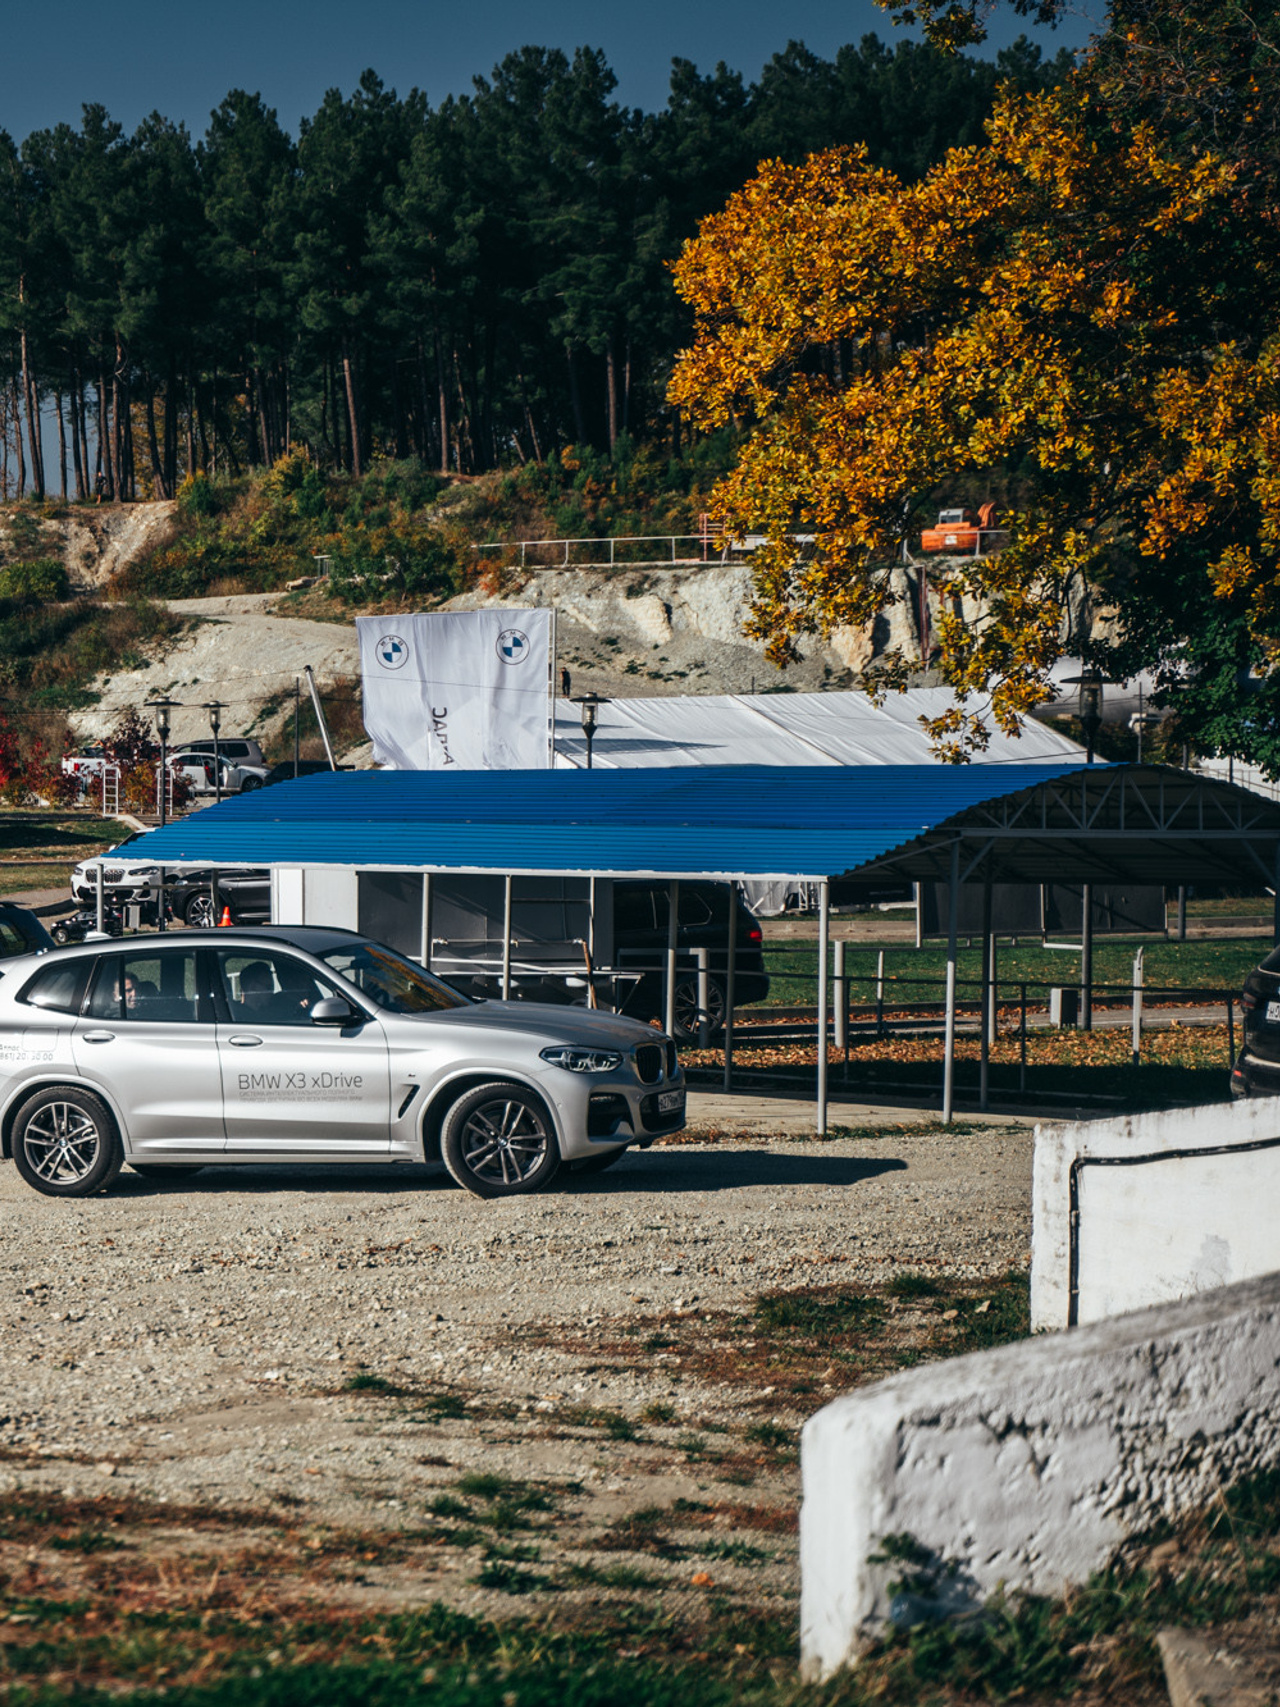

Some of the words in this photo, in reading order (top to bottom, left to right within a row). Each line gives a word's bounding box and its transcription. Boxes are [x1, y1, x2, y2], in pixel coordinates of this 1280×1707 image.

[238, 1073, 281, 1090] BMW
[285, 1072, 307, 1089] X3
[311, 1072, 363, 1089] xDrive
